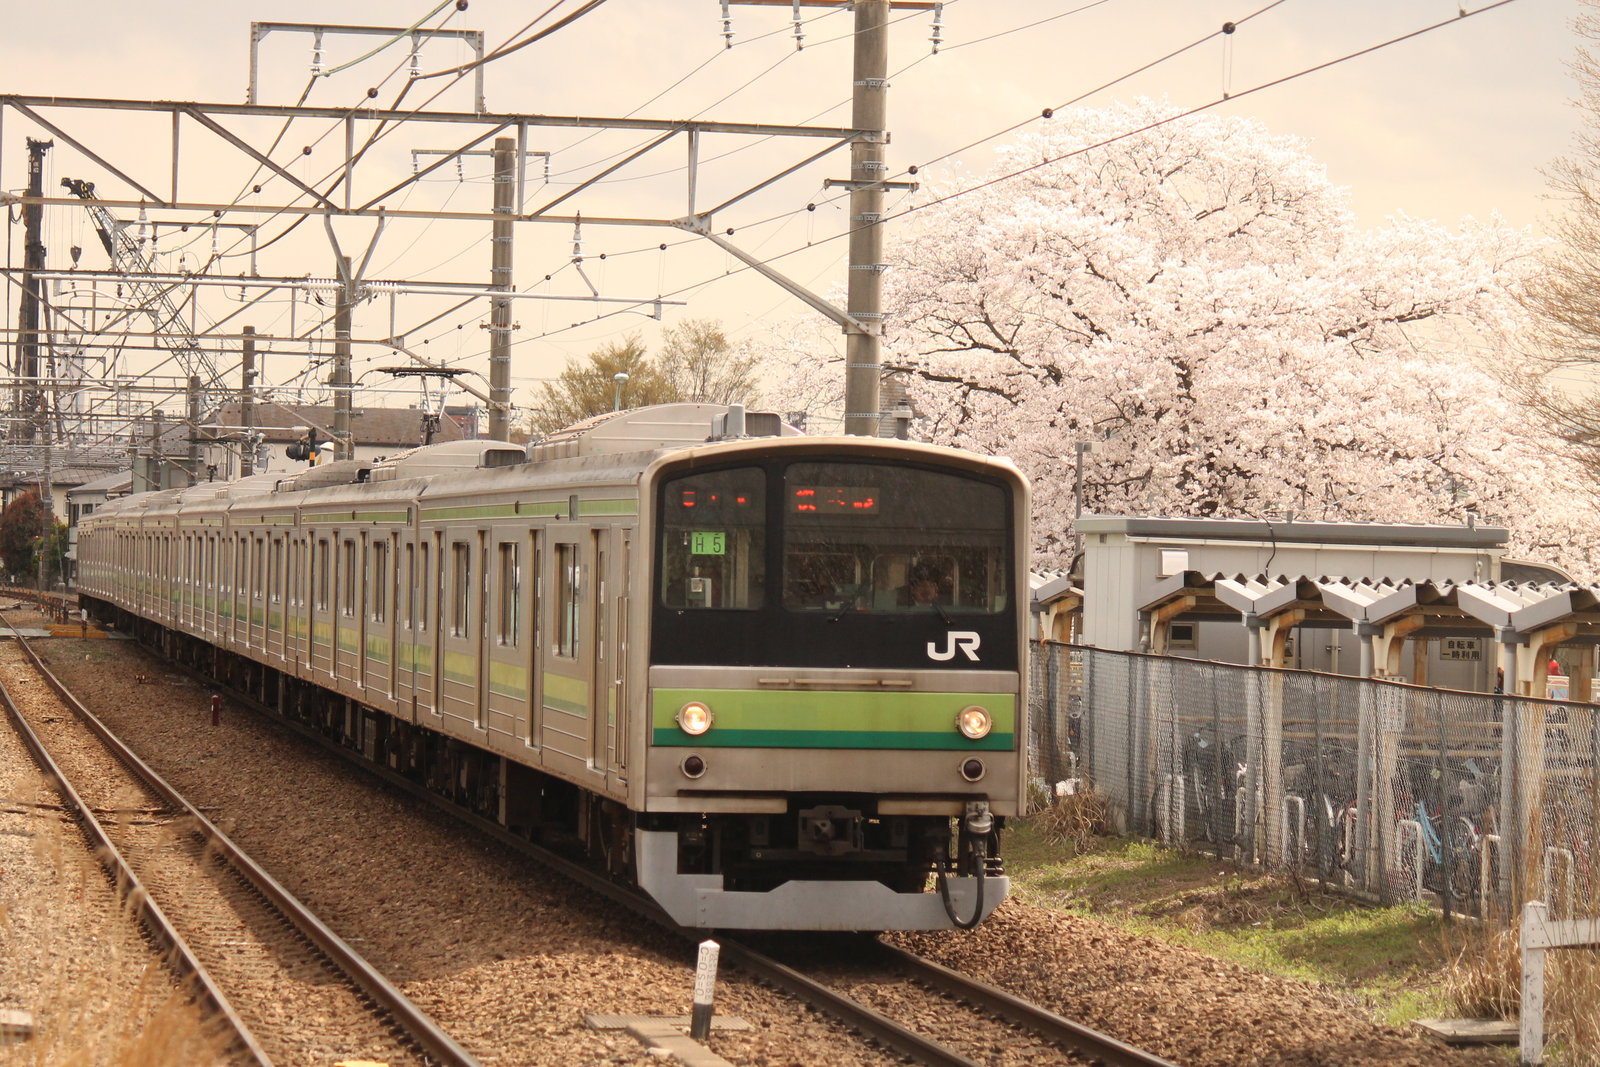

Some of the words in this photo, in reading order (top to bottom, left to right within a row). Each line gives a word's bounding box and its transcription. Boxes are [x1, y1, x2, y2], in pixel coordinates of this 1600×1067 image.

[713, 537, 722, 553] 5
[928, 631, 981, 661] JR
[1448, 640, 1475, 650] 自転車
[1442, 650, 1480, 660] 一時利用
